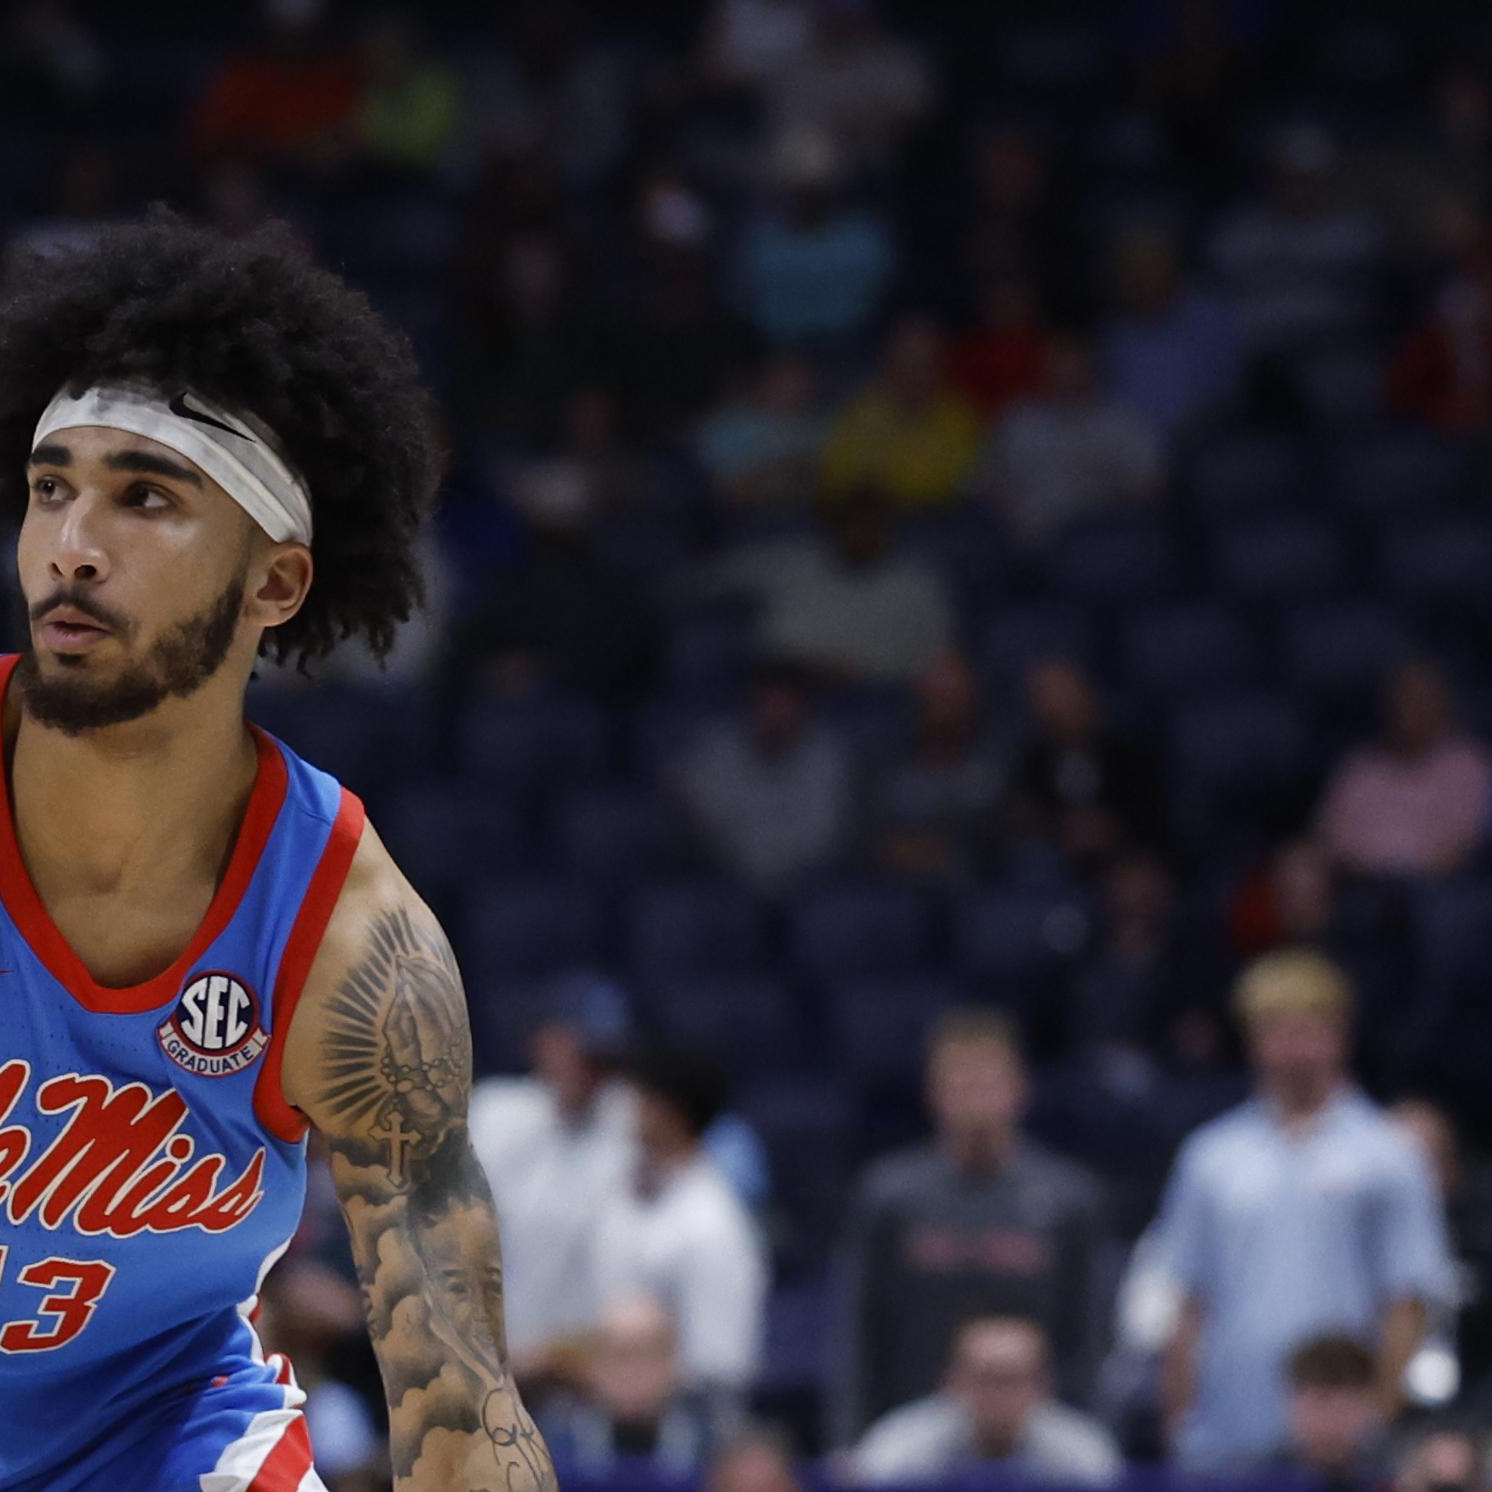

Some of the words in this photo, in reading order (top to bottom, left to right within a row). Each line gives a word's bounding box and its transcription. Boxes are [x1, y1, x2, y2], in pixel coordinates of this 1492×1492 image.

[180, 975, 251, 1050] SEC
[167, 1039, 255, 1074] GRADUATE
[8, 1072, 267, 1240] Miss
